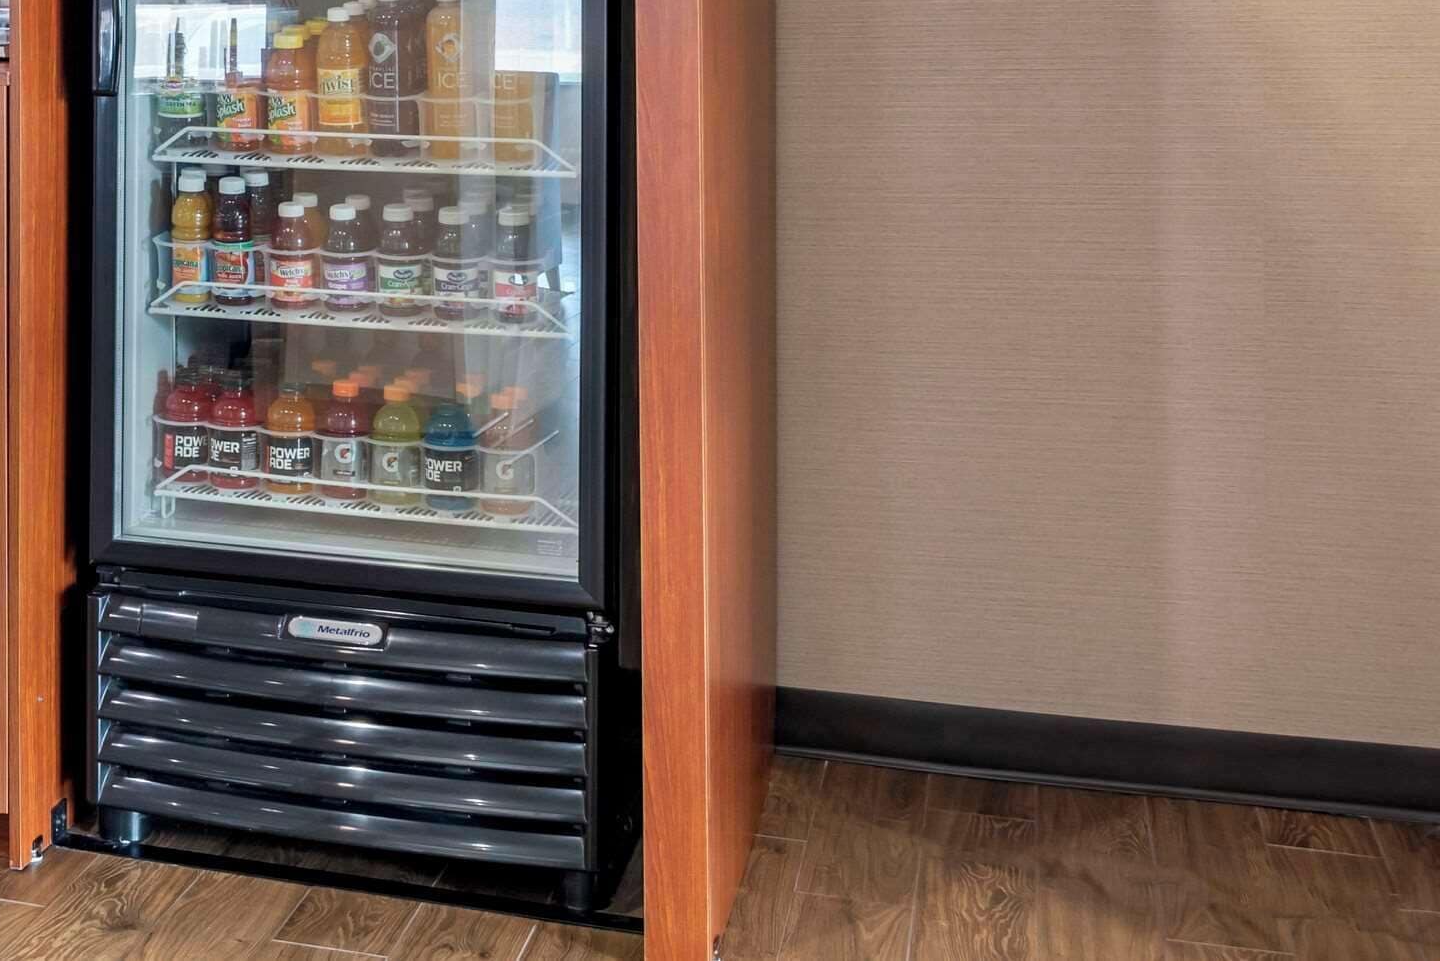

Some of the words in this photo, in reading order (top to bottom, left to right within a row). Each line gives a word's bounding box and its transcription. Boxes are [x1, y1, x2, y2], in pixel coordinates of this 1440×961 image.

[368, 71, 395, 89] ICE
[269, 445, 310, 460] POWER
[334, 443, 354, 463] G
[382, 452, 399, 473] G
[317, 625, 370, 638] Metalfrio
